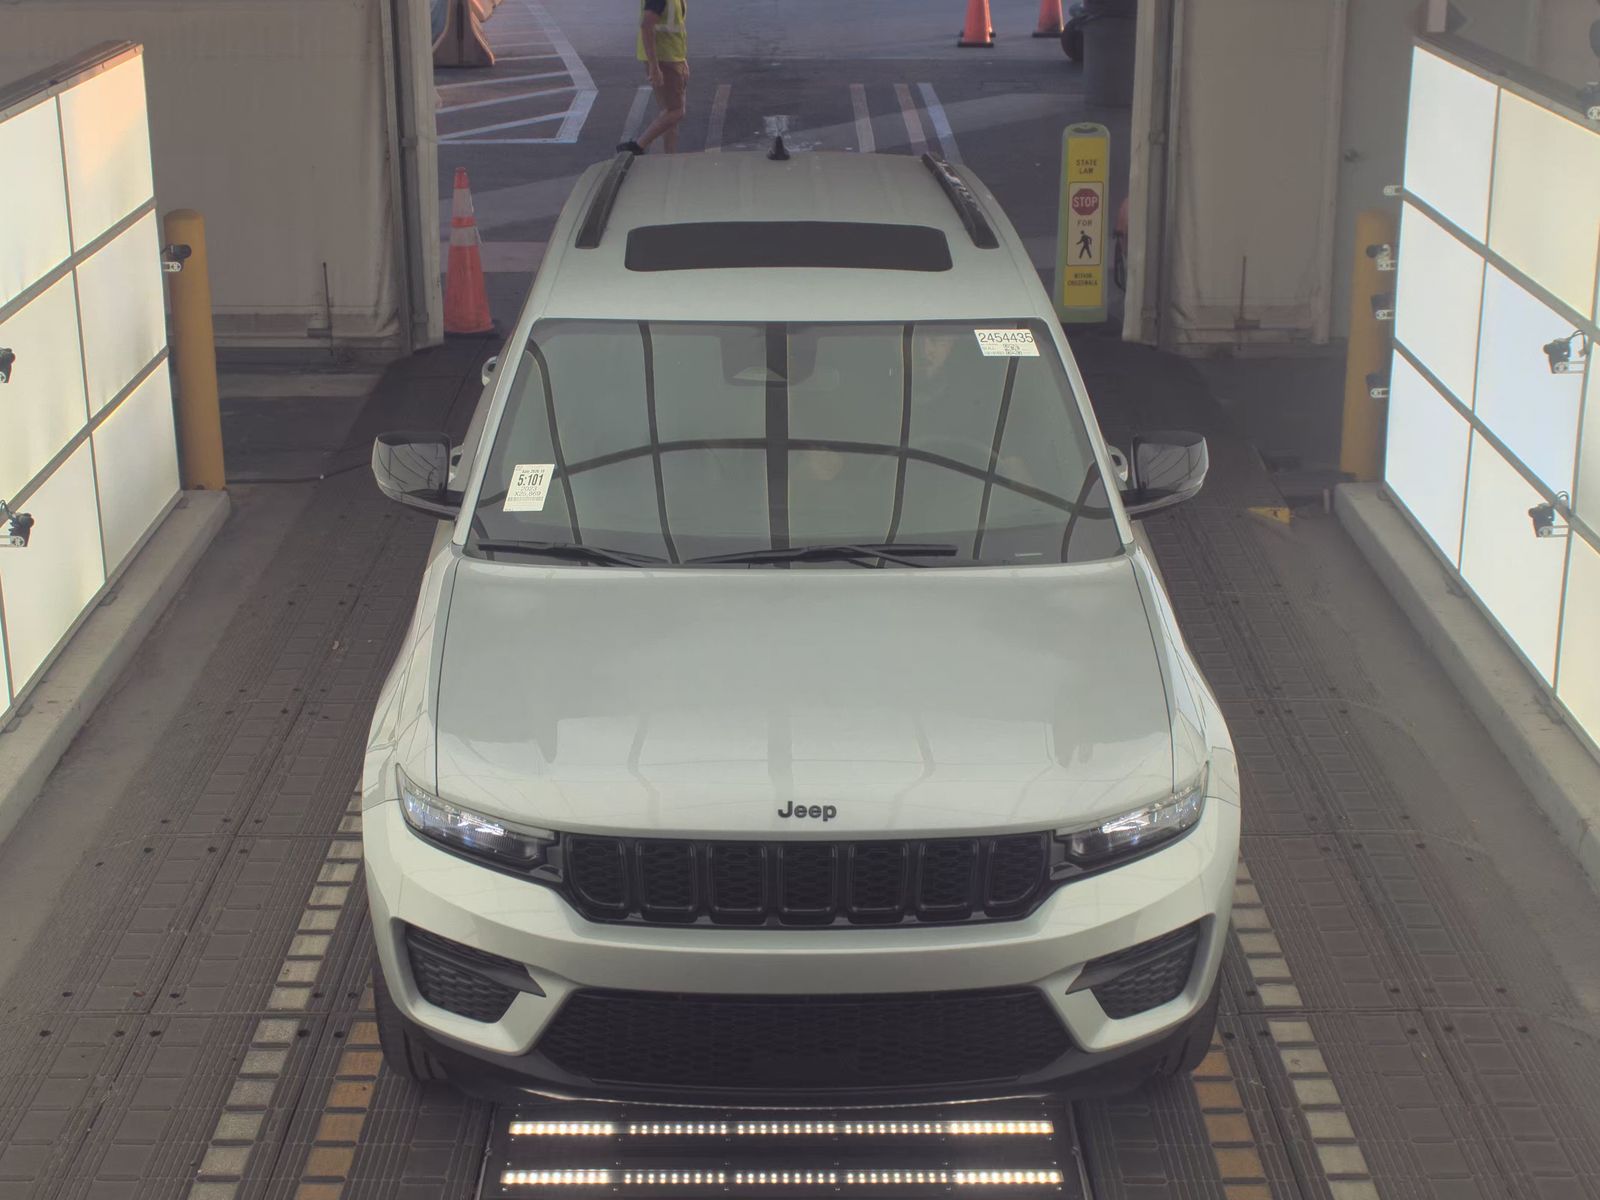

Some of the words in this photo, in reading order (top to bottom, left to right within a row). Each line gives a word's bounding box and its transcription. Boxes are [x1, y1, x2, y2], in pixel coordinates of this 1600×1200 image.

[1075, 159, 1097, 167] STATE
[1079, 167, 1094, 175] LAW
[1072, 196, 1098, 208] STOP
[1077, 219, 1093, 227] FOR
[978, 332, 1035, 343] 2454435
[517, 473, 544, 487] 5:101
[777, 800, 837, 822] Jeep
